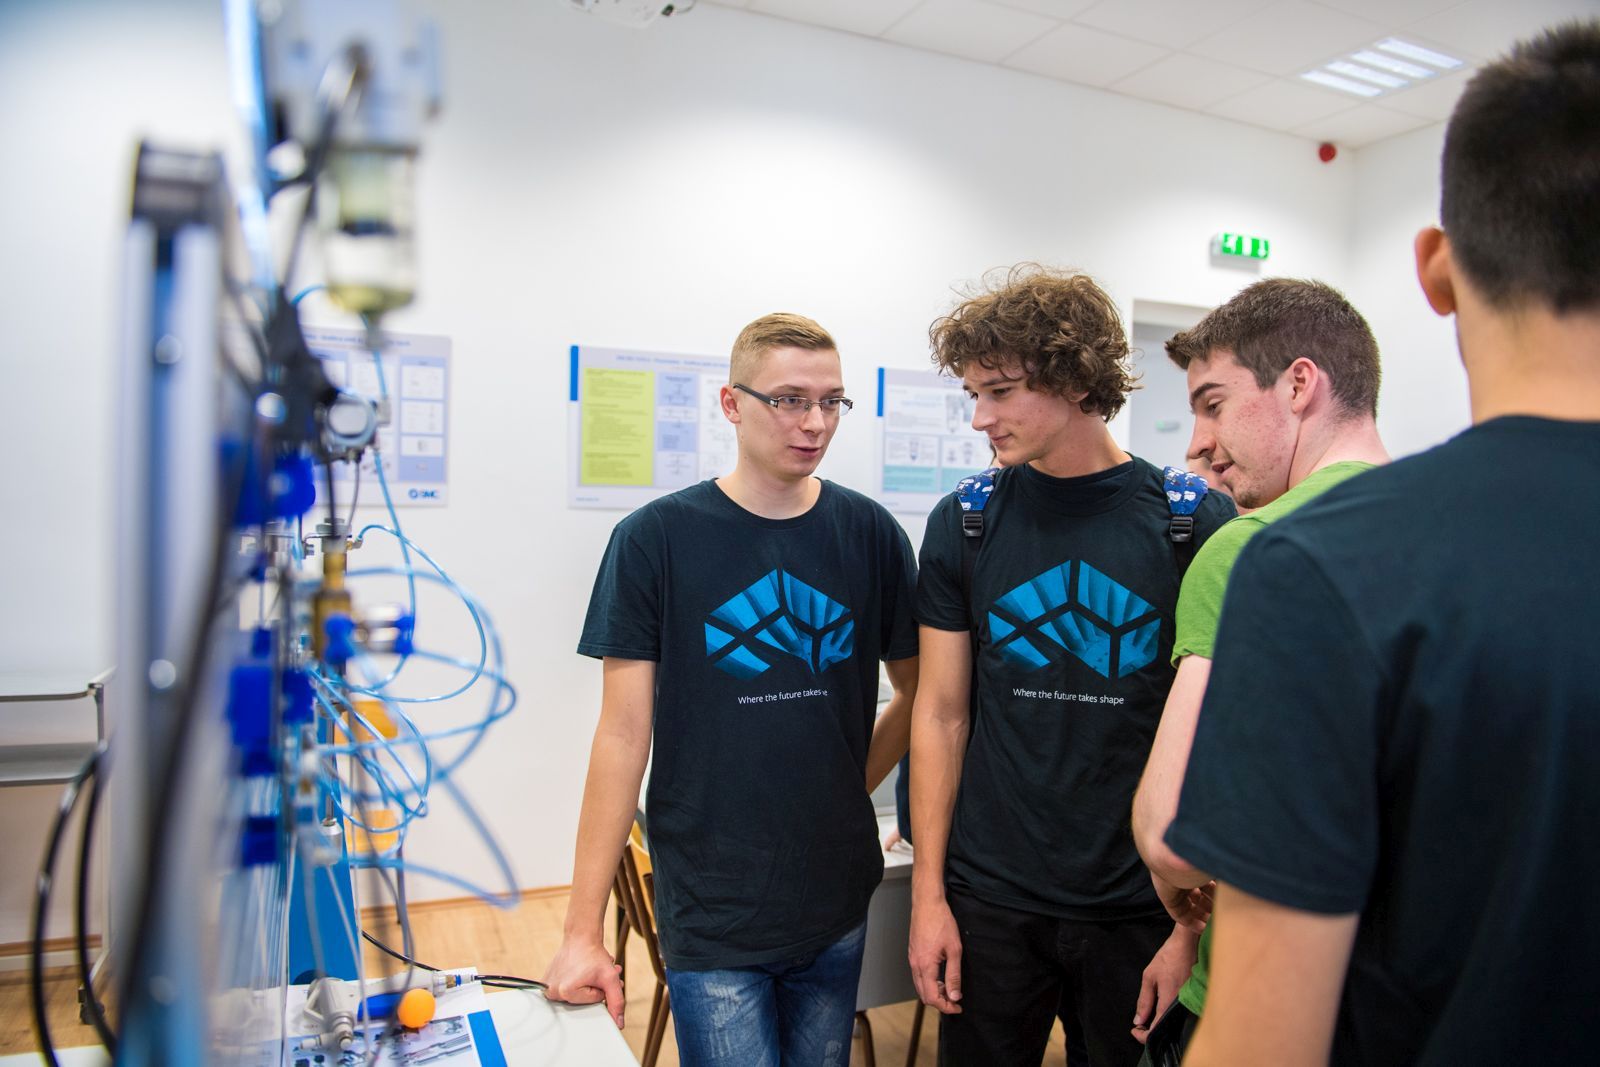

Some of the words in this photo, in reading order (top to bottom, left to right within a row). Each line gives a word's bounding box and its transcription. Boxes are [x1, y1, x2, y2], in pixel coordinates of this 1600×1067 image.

[738, 696, 763, 704] Where
[765, 693, 778, 702] the
[779, 692, 802, 700] future
[803, 689, 821, 697] takes
[1013, 688, 1037, 698] Where
[1038, 690, 1052, 699] the
[1054, 691, 1077, 701] future
[1078, 693, 1098, 703] takes
[1099, 695, 1124, 706] shape
